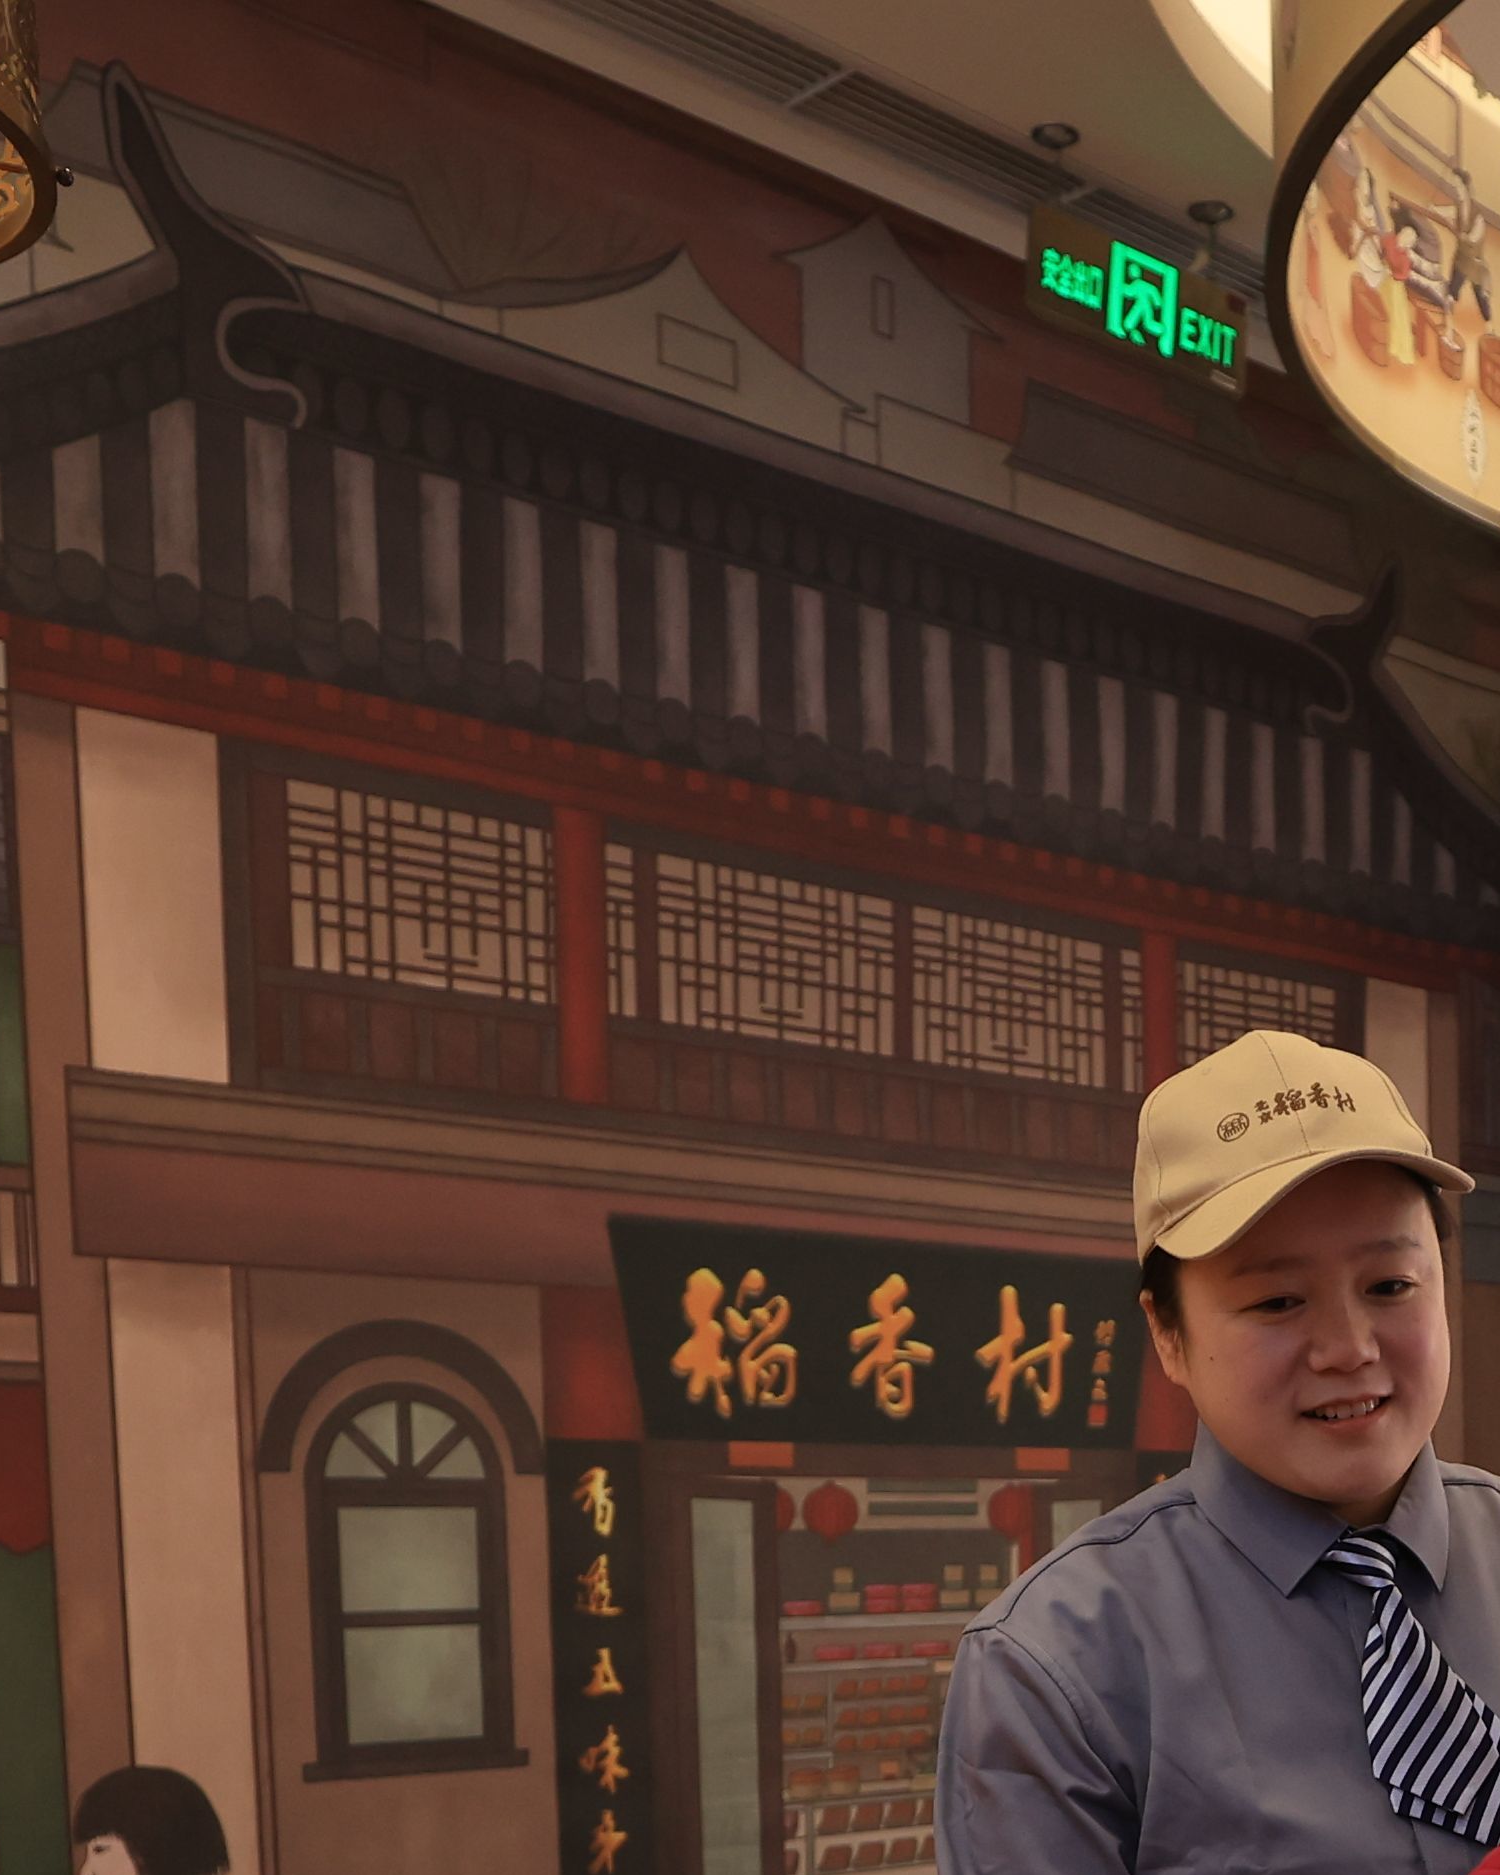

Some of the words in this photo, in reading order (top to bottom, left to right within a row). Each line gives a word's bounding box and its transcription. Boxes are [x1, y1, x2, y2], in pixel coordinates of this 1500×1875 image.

[1041, 247, 1105, 310] 安全出口
[1179, 306, 1238, 368] EXIT
[669, 1266, 1074, 1425] 稻香村
